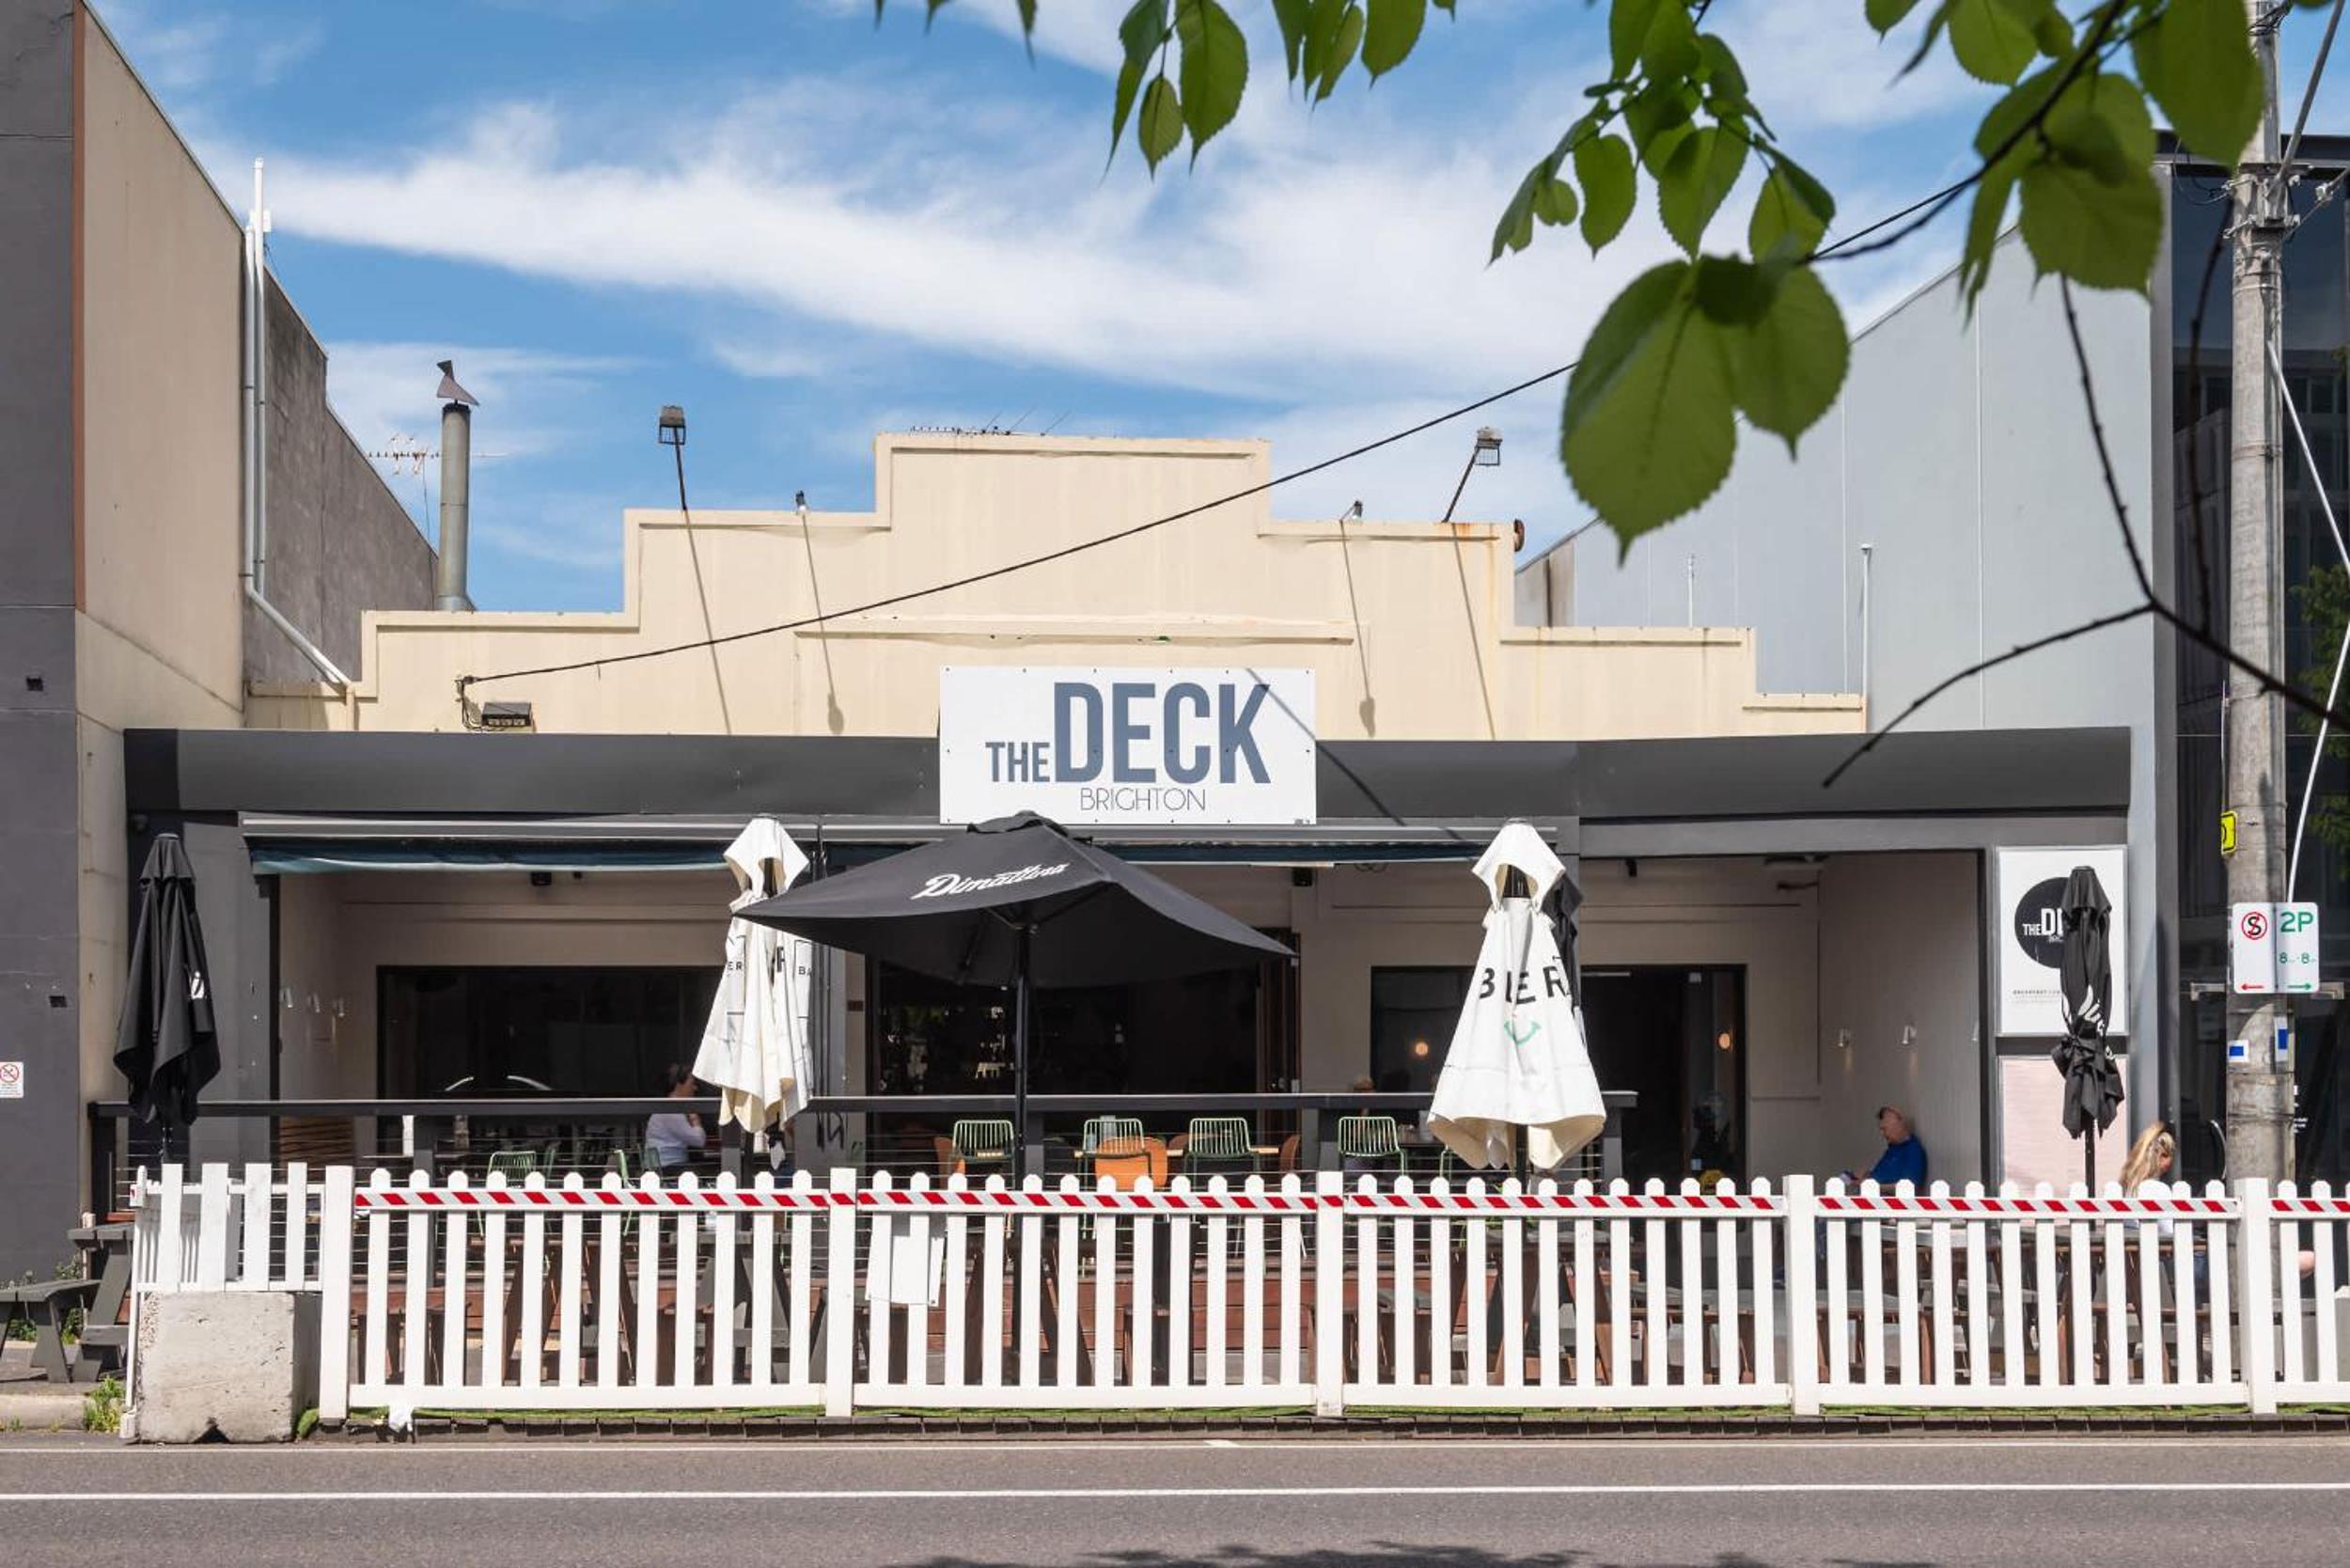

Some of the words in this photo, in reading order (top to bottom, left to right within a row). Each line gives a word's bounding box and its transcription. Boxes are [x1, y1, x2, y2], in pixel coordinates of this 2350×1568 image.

[985, 742, 1050, 782] THE
[1054, 682, 1271, 784] DECK
[1080, 787, 1206, 811] BRIGHTON
[2022, 923, 2042, 936] THE
[2280, 911, 2313, 933] 2P
